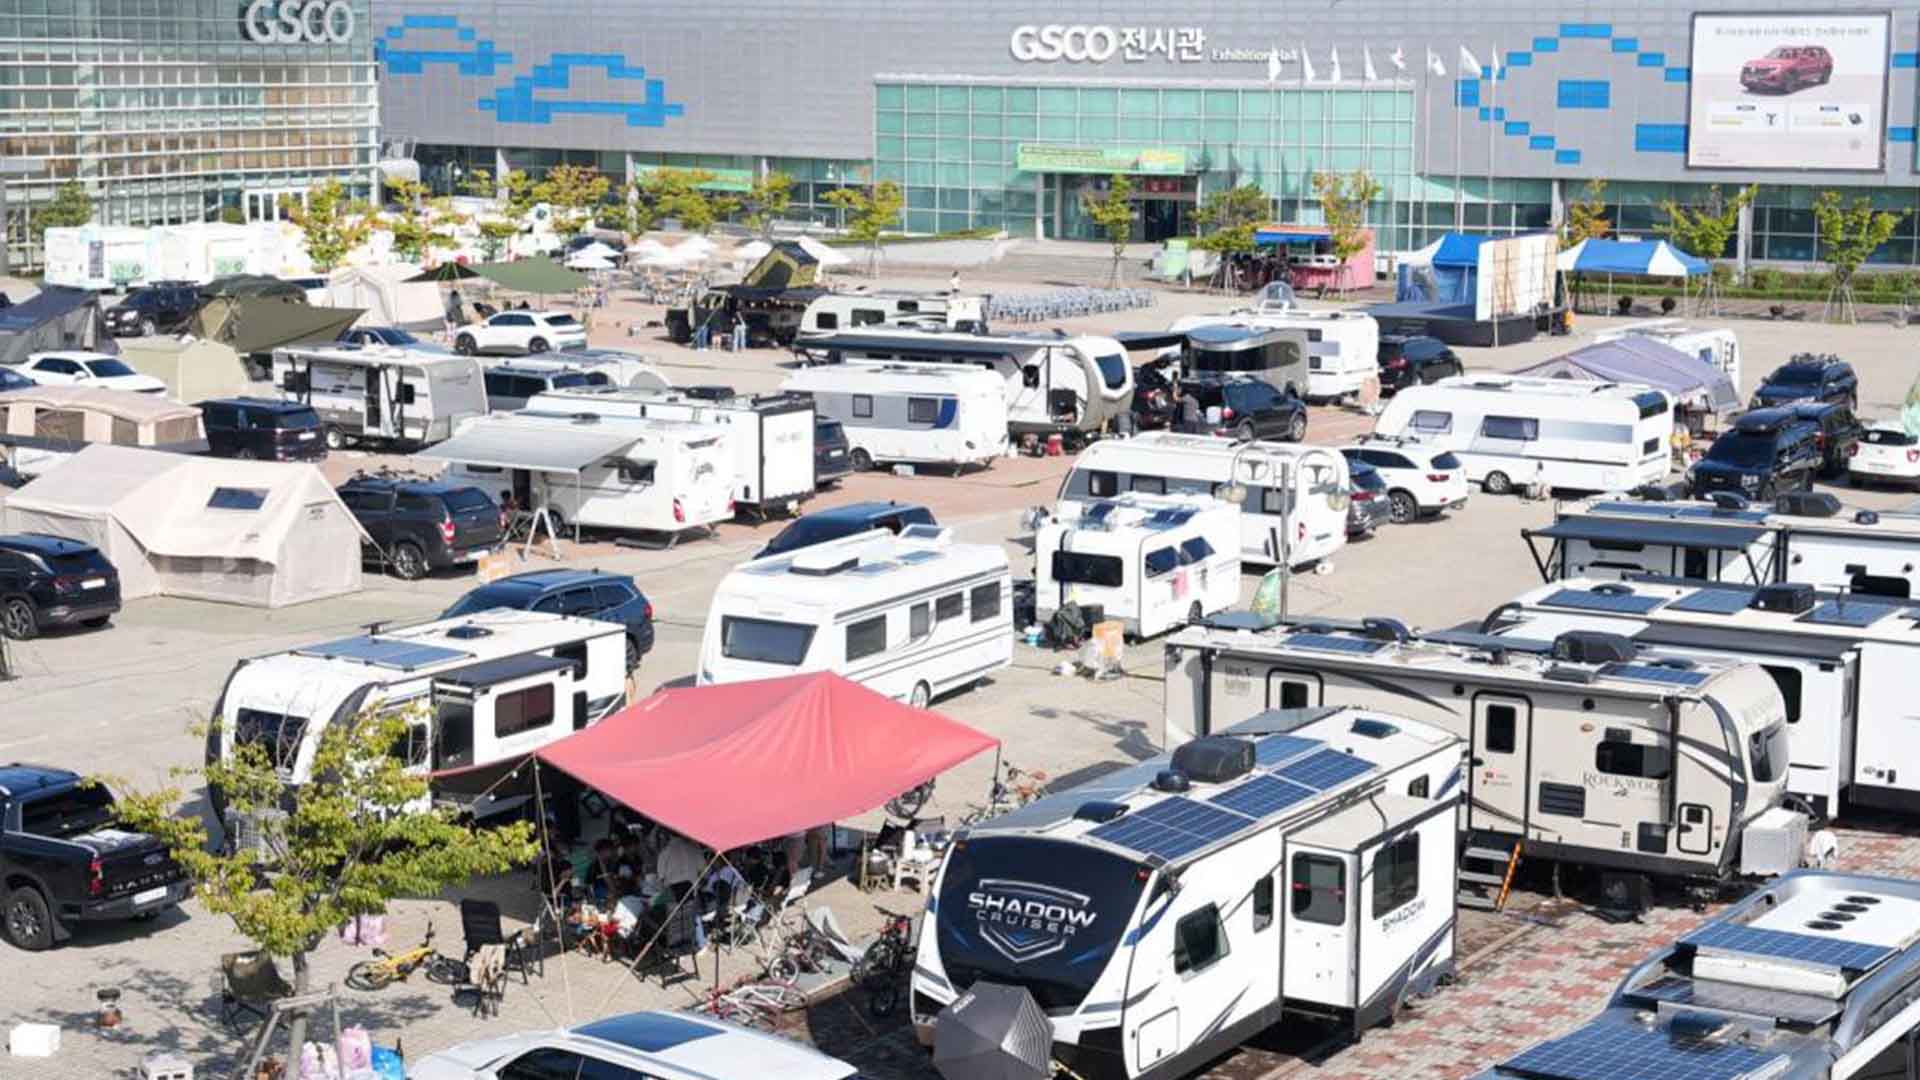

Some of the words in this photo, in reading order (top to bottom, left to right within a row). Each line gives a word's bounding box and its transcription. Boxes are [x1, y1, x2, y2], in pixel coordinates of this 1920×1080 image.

[245, 0, 353, 43] GSCO
[1011, 25, 1117, 61] GSCO
[1120, 27, 1206, 61] 전시관
[968, 892, 1097, 927] SHADOW
[975, 909, 1076, 936] CRUISER
